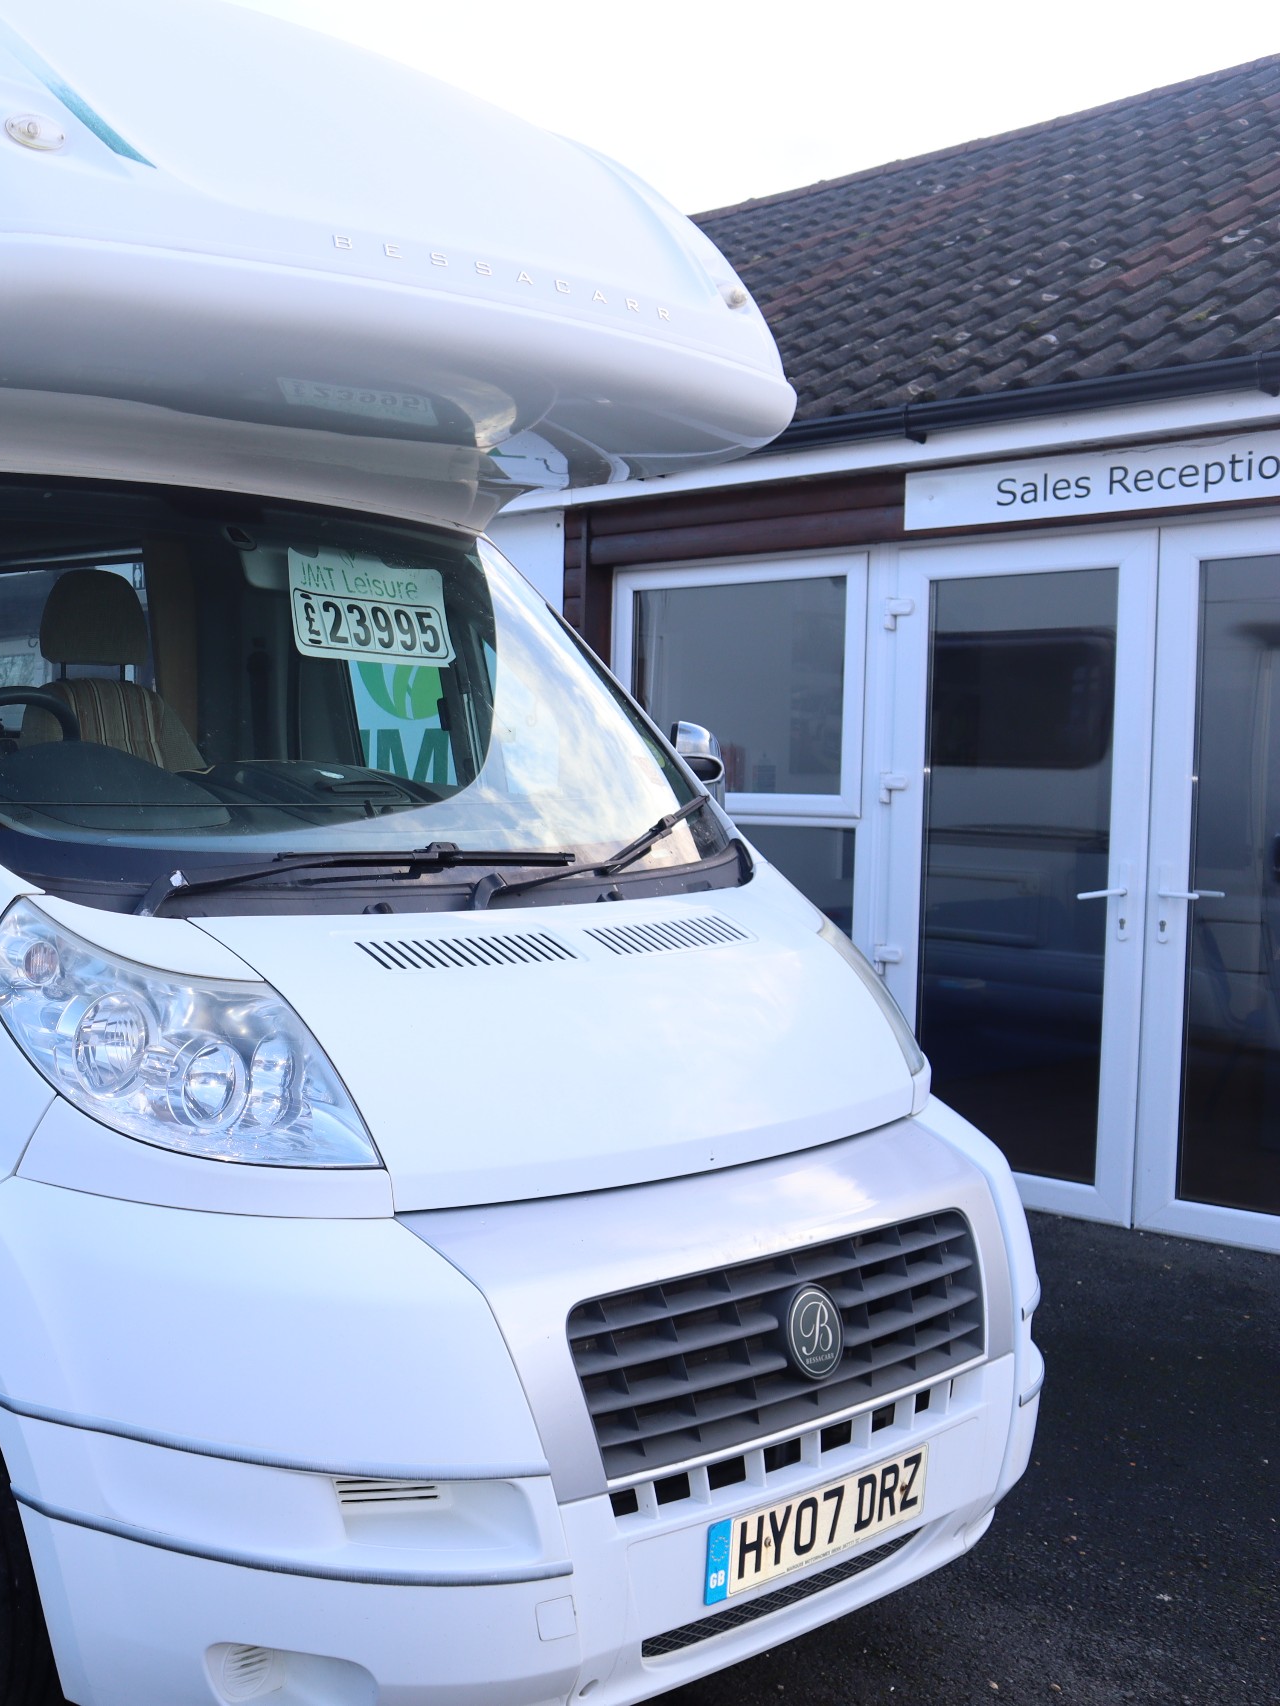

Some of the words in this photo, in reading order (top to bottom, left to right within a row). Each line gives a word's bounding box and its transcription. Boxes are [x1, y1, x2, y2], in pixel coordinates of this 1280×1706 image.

[332, 234, 671, 322] BESSACARR
[996, 473, 1091, 507] Sales
[1108, 450, 1280, 495] Receptio
[300, 562, 336, 592] JMT
[341, 569, 418, 600] Leisure
[303, 600, 441, 653] £23995
[800, 1301, 833, 1356] B
[805, 1353, 835, 1365] BESSACARR
[737, 1484, 846, 1580] HY07
[853, 1451, 923, 1534] DRZ
[709, 1569, 726, 1589] GB
